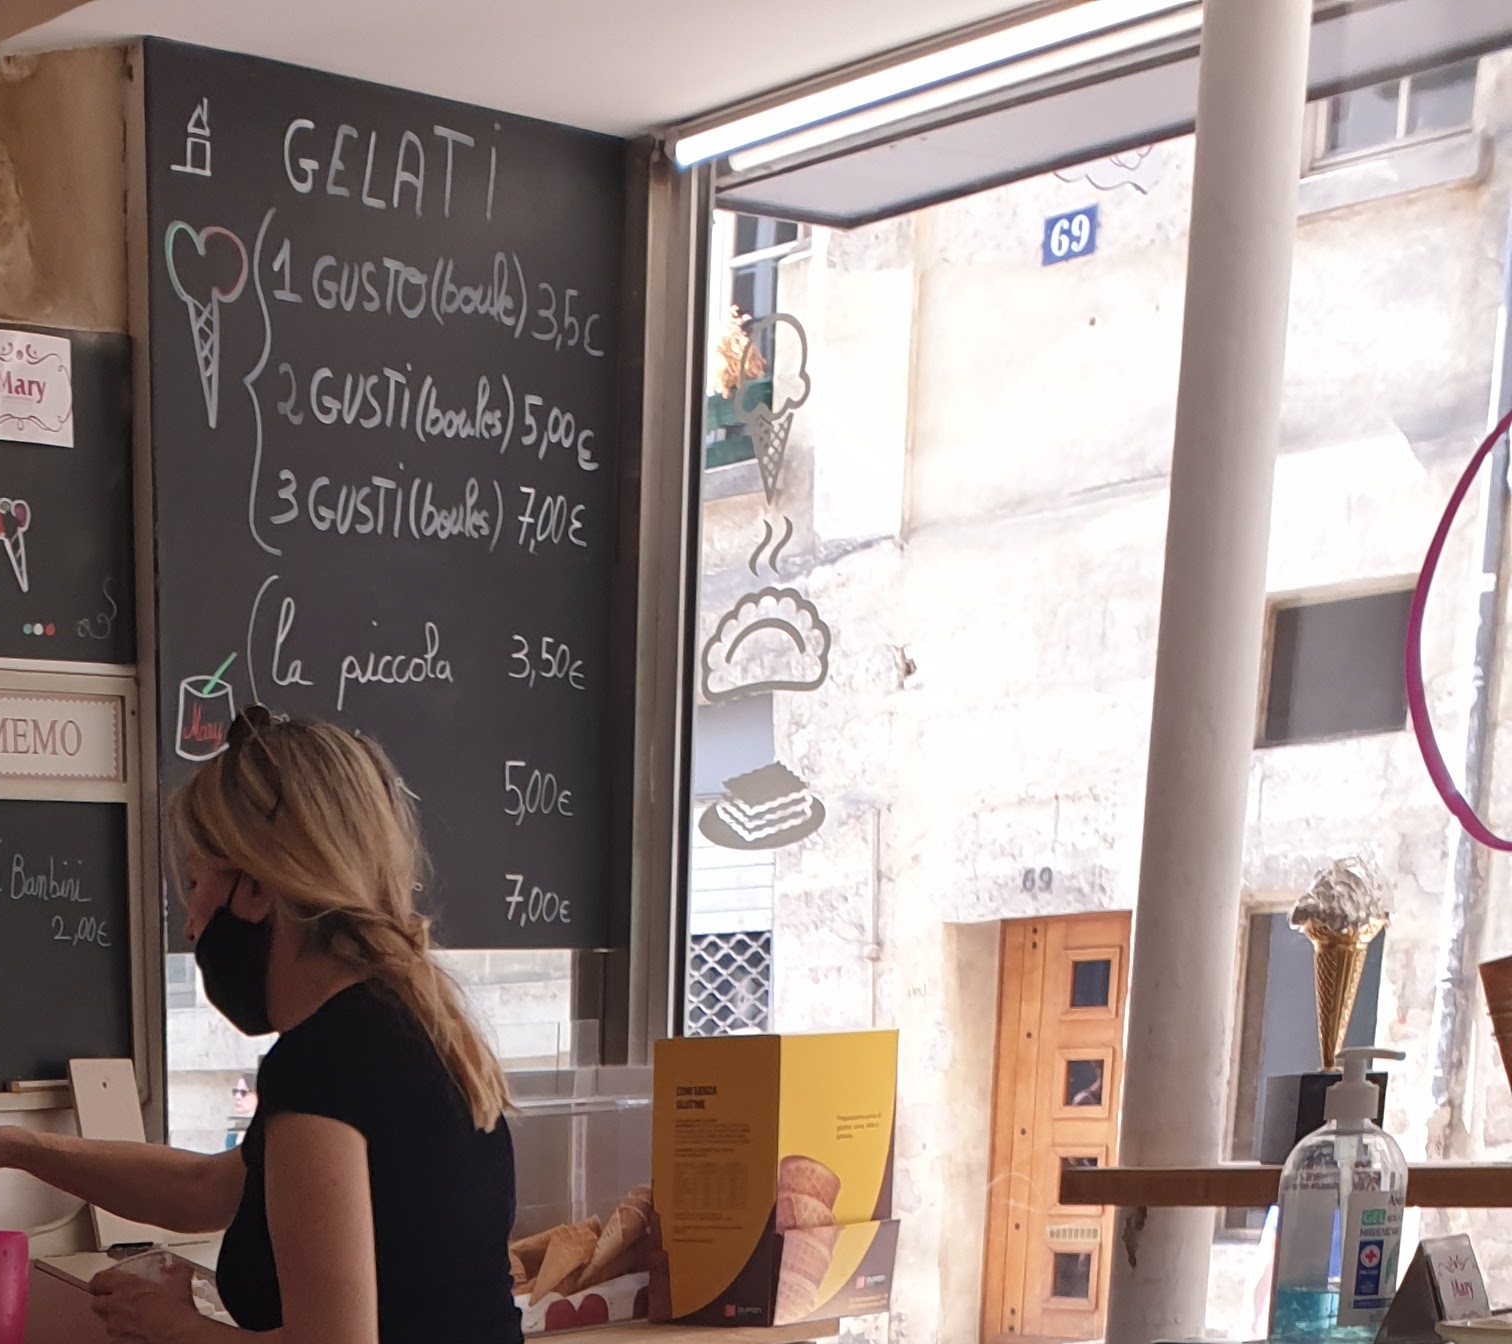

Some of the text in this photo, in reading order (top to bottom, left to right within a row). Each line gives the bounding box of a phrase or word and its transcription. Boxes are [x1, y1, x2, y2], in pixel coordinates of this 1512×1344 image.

[1048, 213, 1090, 258] 69
[521, 390, 599, 473] 5,00€
[270, 469, 299, 526] 3
[516, 484, 588, 557] 7,00€
[337, 621, 455, 708] piccola
[507, 633, 586, 691] 3,50€
[504, 759, 574, 820] 5,00€
[504, 874, 572, 925] 7,00€
[52, 915, 112, 948] 2,00€
